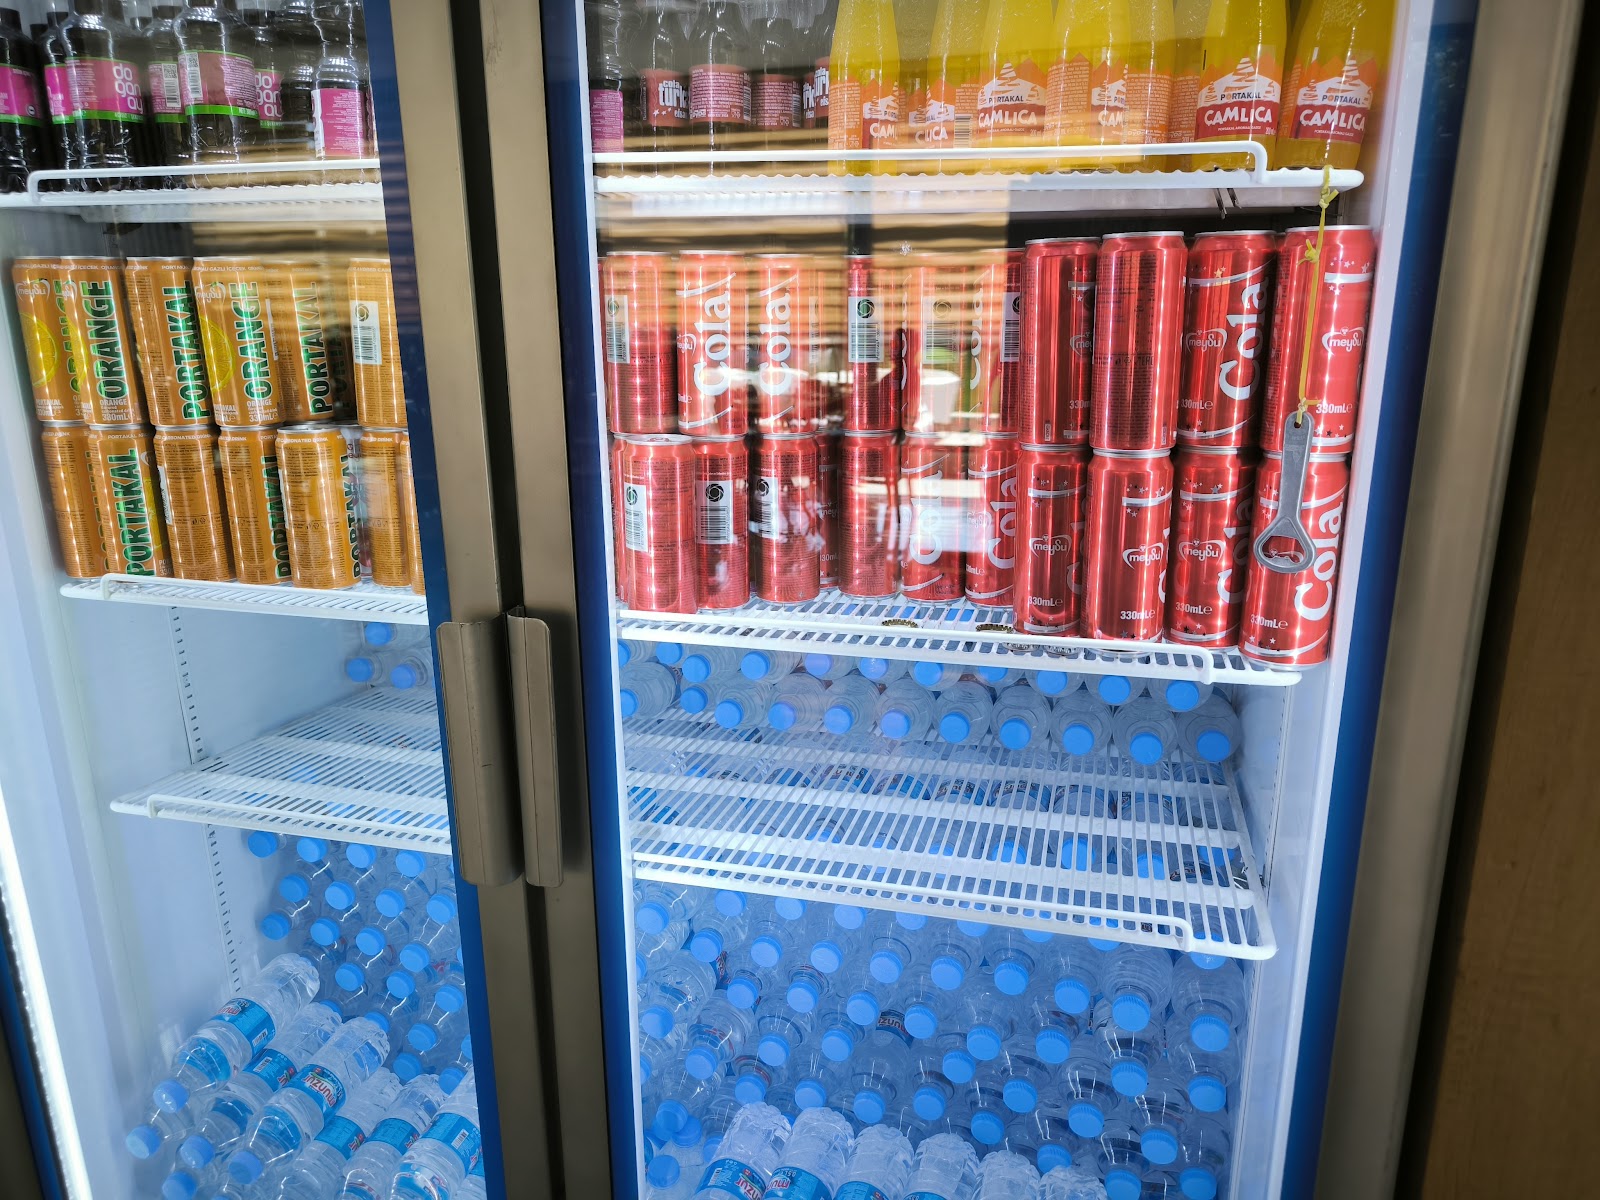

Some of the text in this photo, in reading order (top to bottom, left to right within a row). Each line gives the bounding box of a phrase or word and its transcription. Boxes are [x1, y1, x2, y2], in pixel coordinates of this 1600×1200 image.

[113, 63, 133, 80] do
[1220, 92, 1262, 101] PORTAKAL
[1321, 94, 1361, 105] PORTAKAL
[79, 280, 130, 400] ORANGE
[162, 280, 211, 420] PORTAKAL
[228, 281, 273, 400] ORANGE
[293, 281, 334, 415] PORTAKAL
[693, 290, 732, 396] Cola
[759, 291, 793, 396] Cola
[1218, 276, 1270, 400] Cola
[246, 399, 273, 407] ORANGE
[107, 447, 157, 577] PORTAKAL
[1293, 500, 1344, 622] Cola
[304, 1074, 337, 1107] munzur
